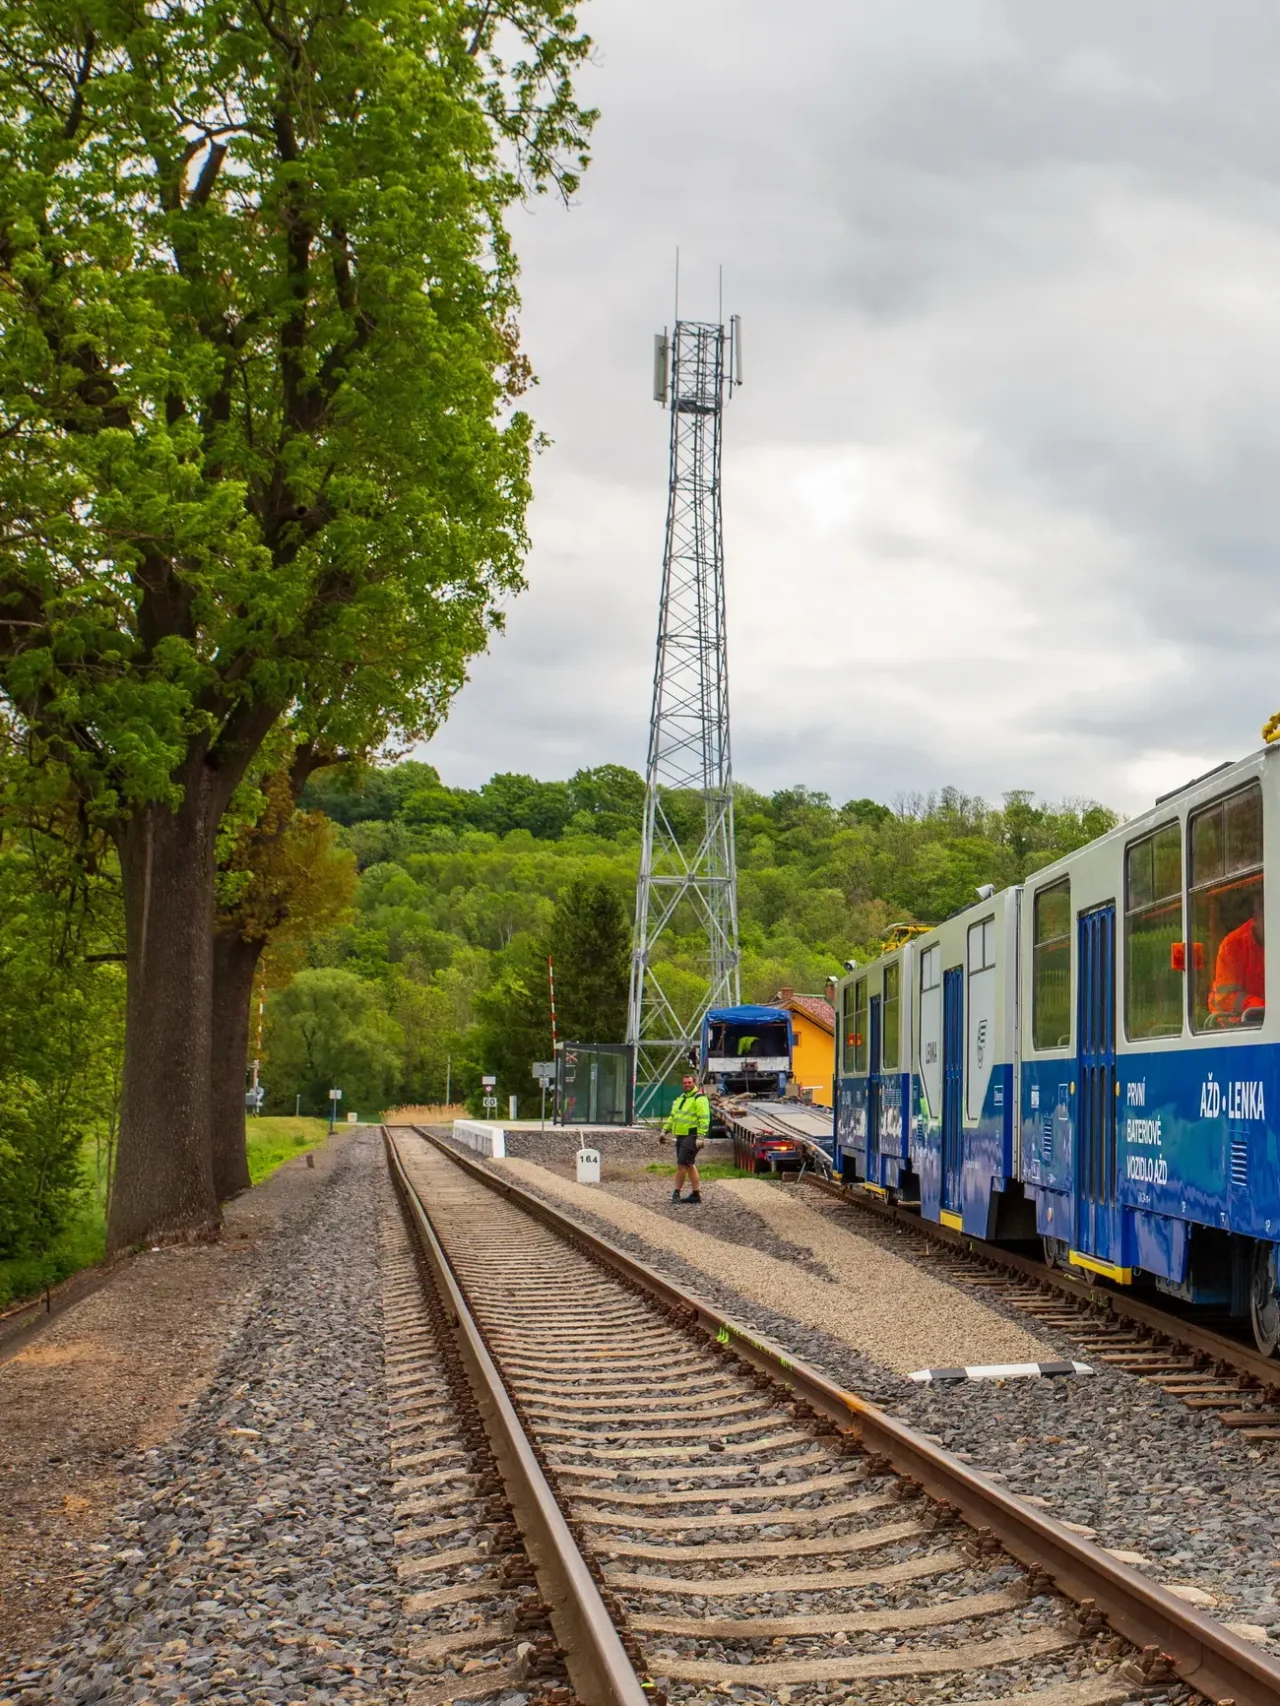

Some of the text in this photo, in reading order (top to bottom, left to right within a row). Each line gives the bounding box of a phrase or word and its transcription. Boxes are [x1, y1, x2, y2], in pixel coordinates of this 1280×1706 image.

[1127, 1077, 1145, 1106] PRVNÍ
[1200, 1072, 1266, 1120] AŽD LENKA
[1127, 1115, 1161, 1145] BATERIOVÉ
[1127, 1154, 1167, 1185] VOZIDLO AŽD
